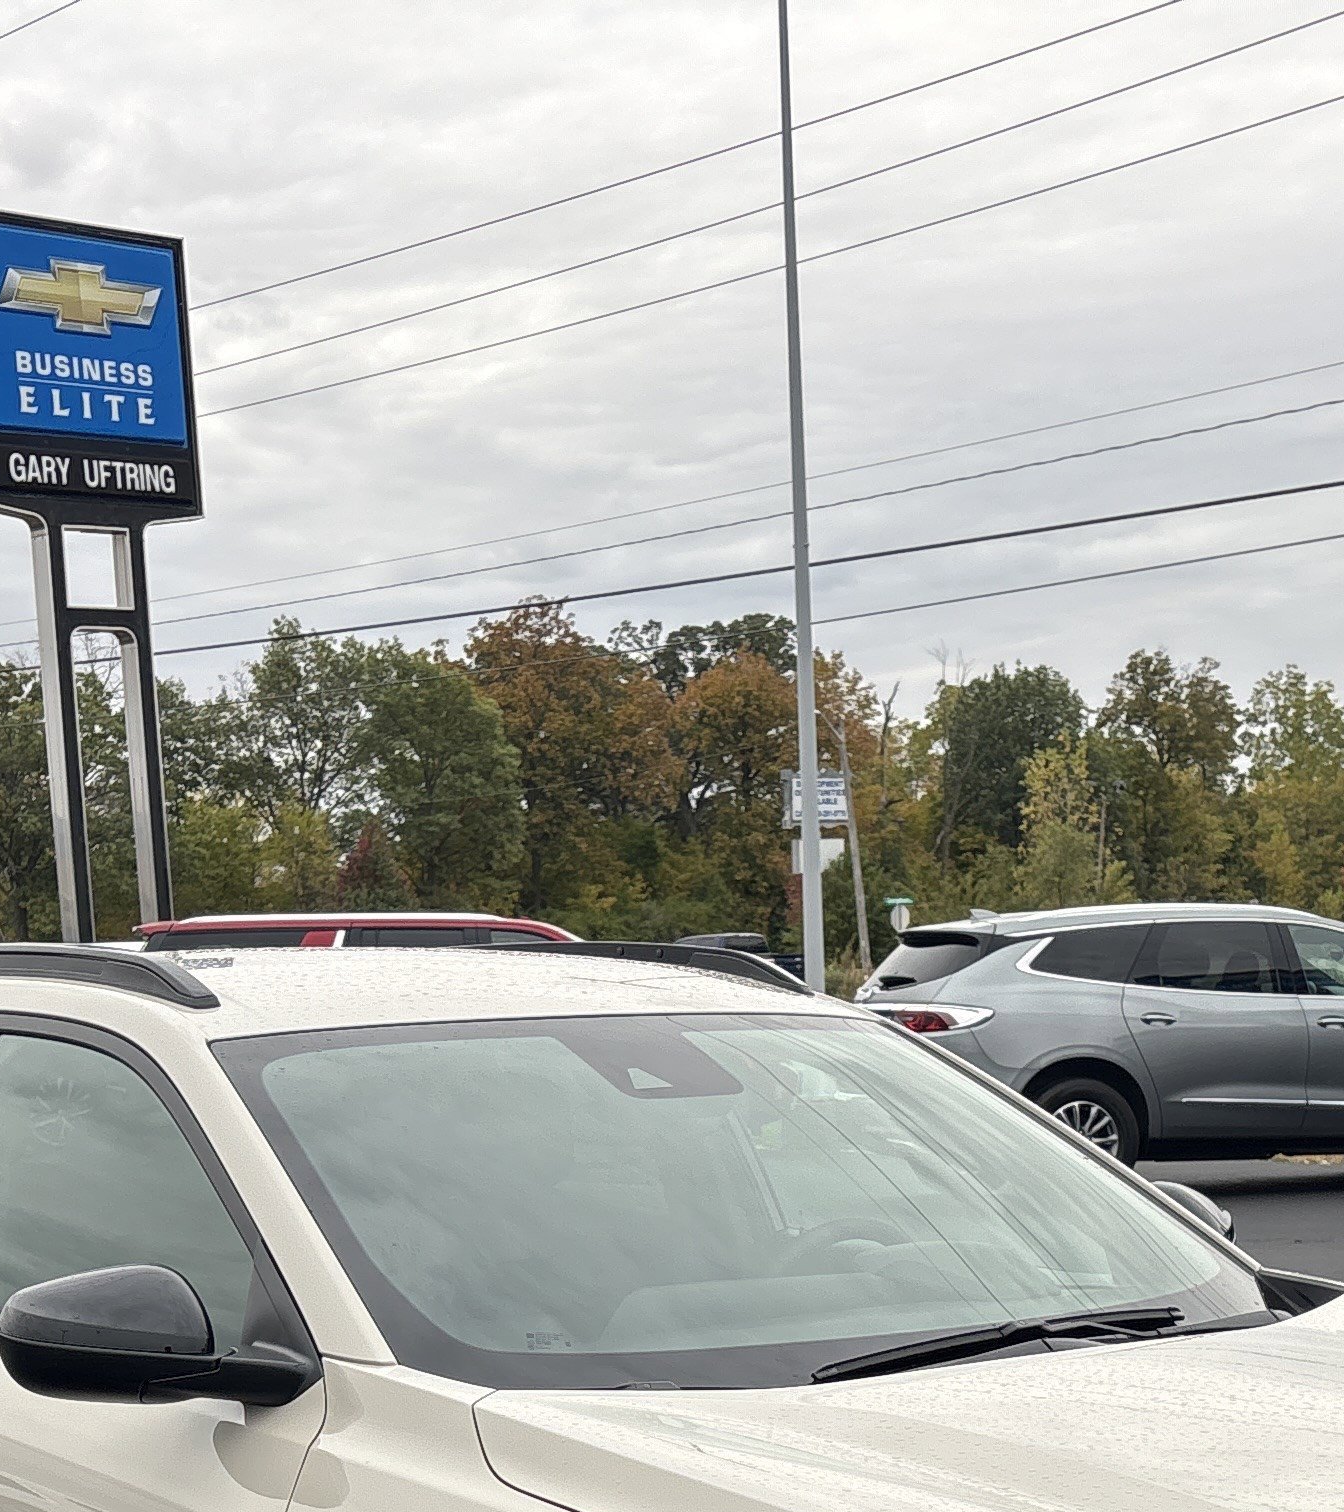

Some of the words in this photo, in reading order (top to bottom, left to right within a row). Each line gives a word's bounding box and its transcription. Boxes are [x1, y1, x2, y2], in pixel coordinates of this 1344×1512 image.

[15, 350, 153, 387] BUSINESS
[18, 385, 156, 425] ELITE
[8, 452, 71, 486] GARY
[83, 458, 177, 495] UFTRING
